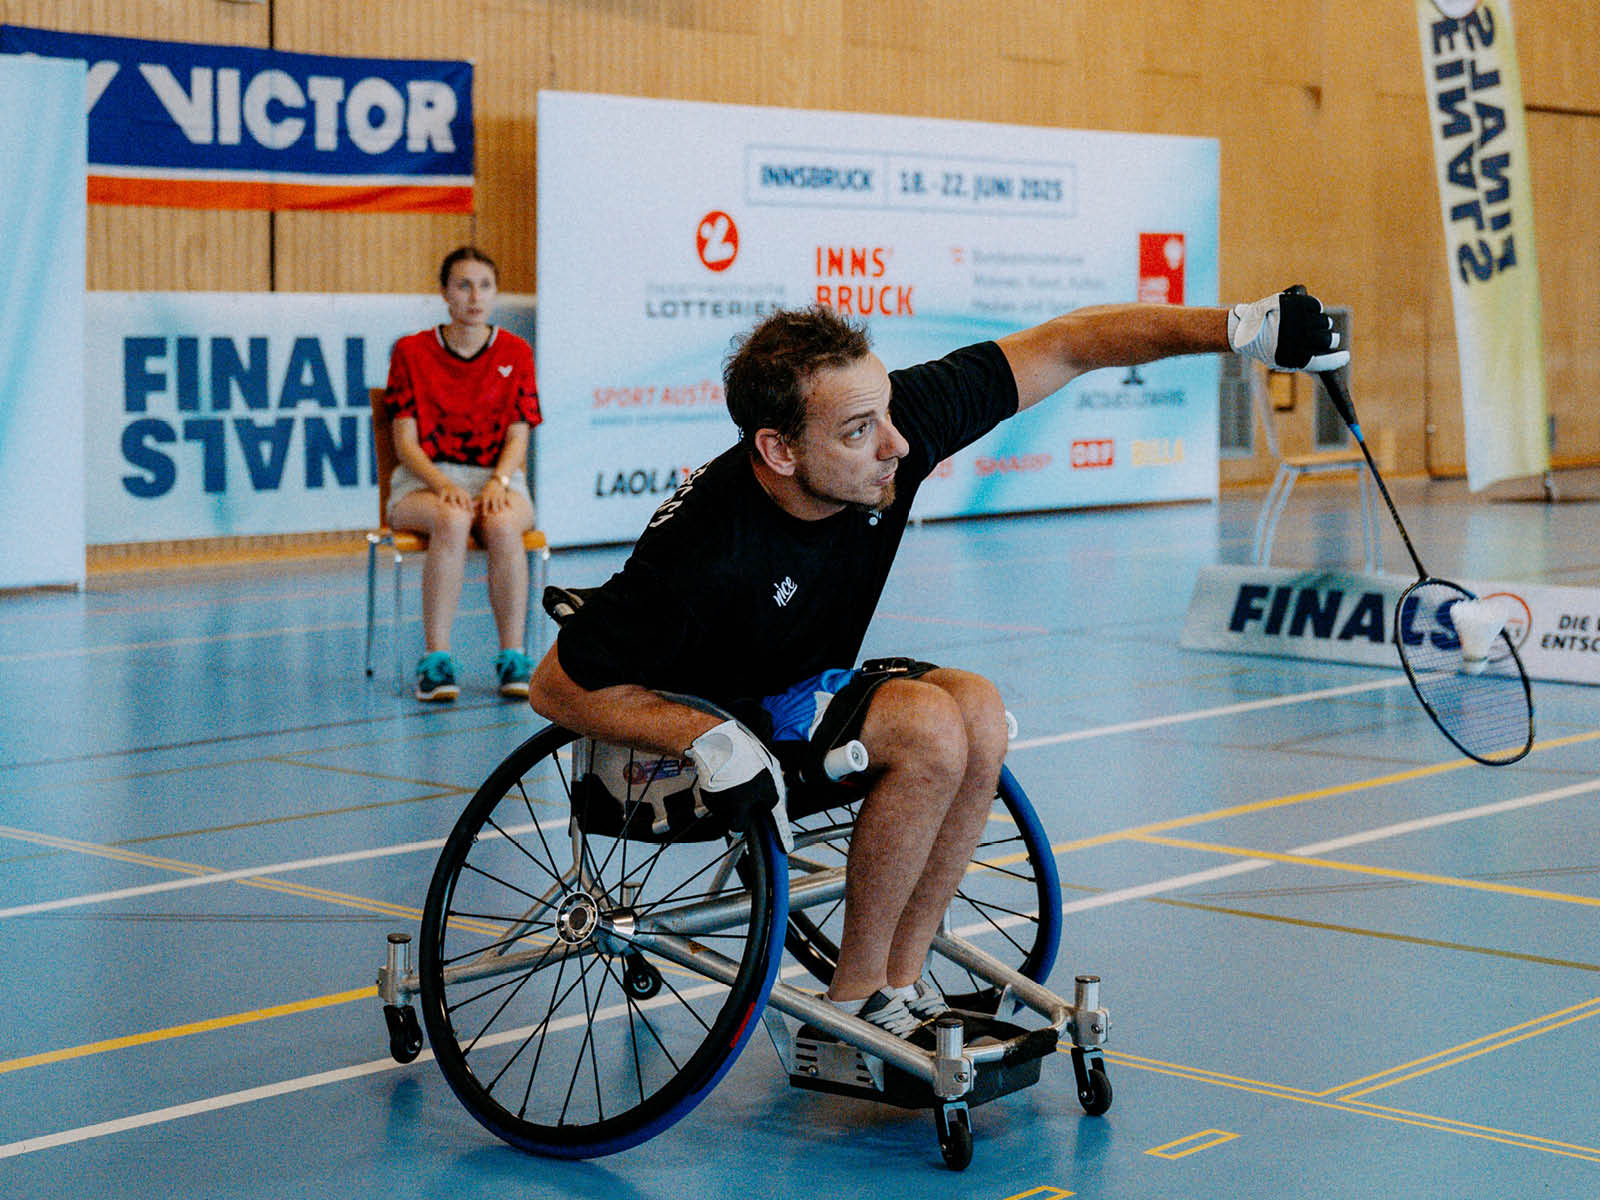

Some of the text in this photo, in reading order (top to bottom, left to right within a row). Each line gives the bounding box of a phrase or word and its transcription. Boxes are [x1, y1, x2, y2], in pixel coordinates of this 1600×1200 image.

[138, 63, 458, 154] VICTOR
[762, 165, 874, 192] INNSBRUCK
[973, 175, 1014, 202] JUNI
[1021, 178, 1064, 202] 2025
[816, 285, 915, 316] BRUCK
[592, 386, 656, 408] SPORT
[773, 576, 798, 607] nice
[1230, 584, 1465, 651] FINALS
[1559, 614, 1591, 632] DIE
